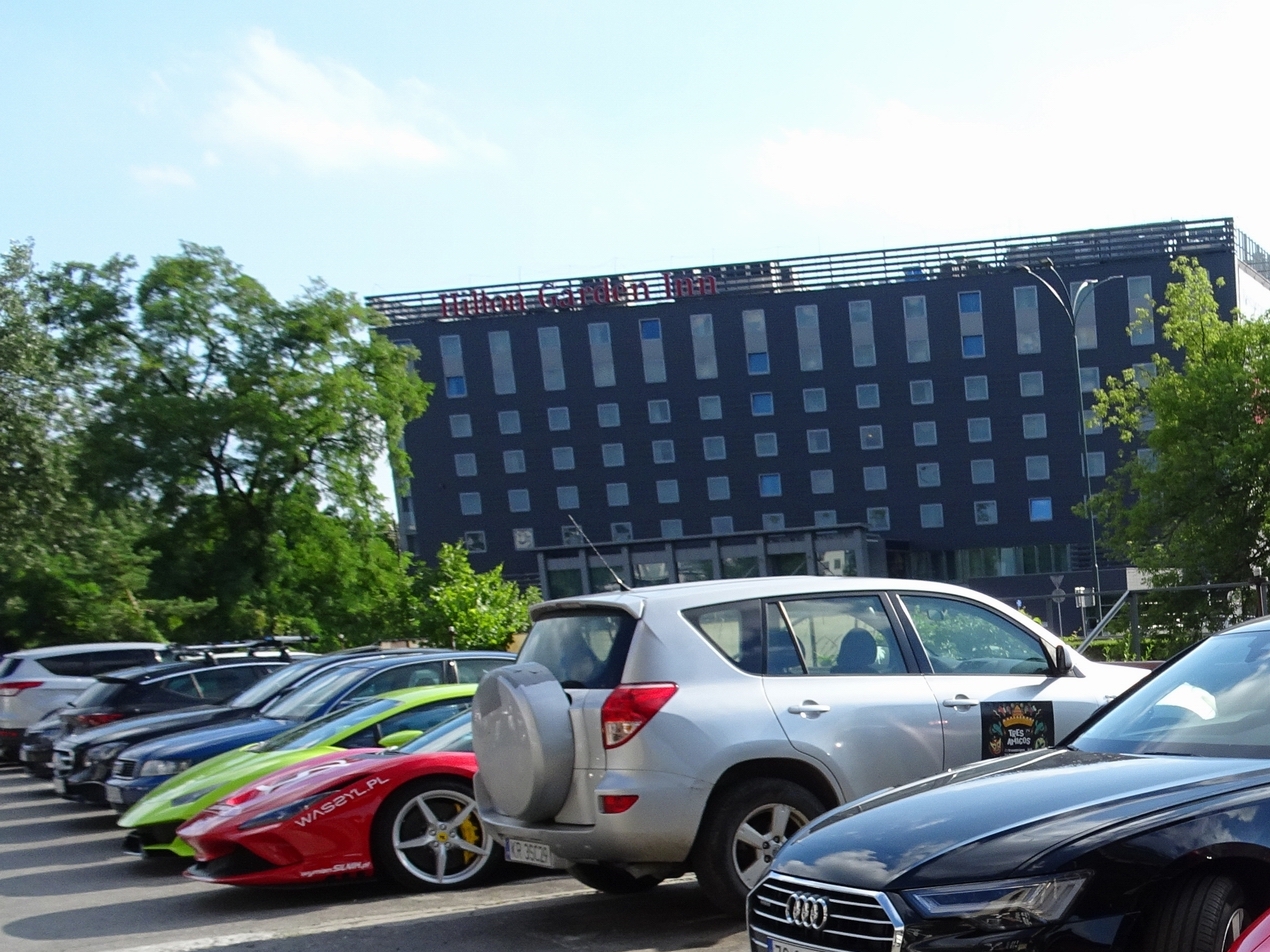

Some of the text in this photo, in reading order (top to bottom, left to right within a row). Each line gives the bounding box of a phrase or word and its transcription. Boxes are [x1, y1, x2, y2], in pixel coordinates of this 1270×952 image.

[439, 272, 717, 317] Hilton Garden Inn
